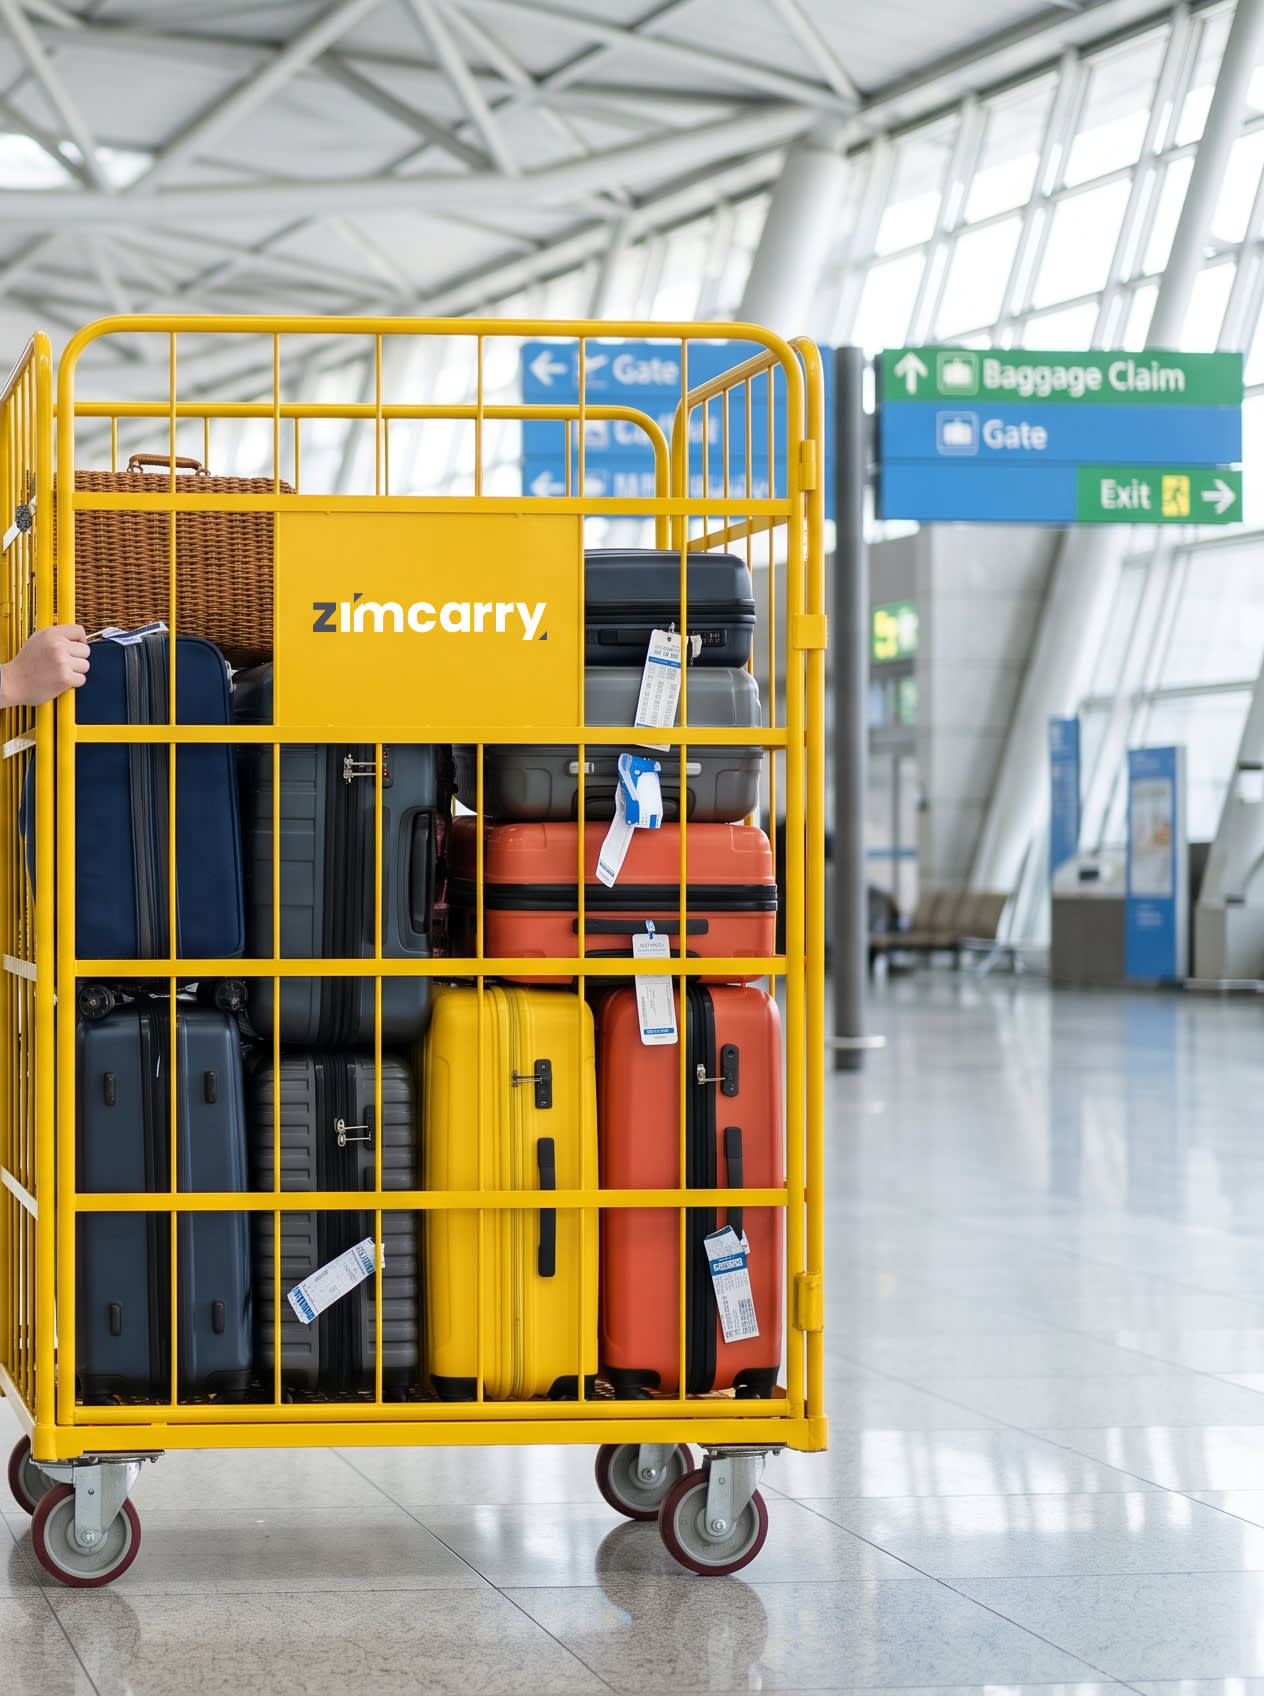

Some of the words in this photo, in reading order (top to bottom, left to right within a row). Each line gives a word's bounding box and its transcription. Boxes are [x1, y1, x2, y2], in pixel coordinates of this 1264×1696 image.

[613, 353, 680, 384] Gate
[982, 358, 1103, 397] Baggage
[1108, 361, 1186, 391] Claim
[983, 419, 1049, 450] Gate
[1100, 478, 1152, 510] Exit
[313, 593, 547, 640] zimcarry
